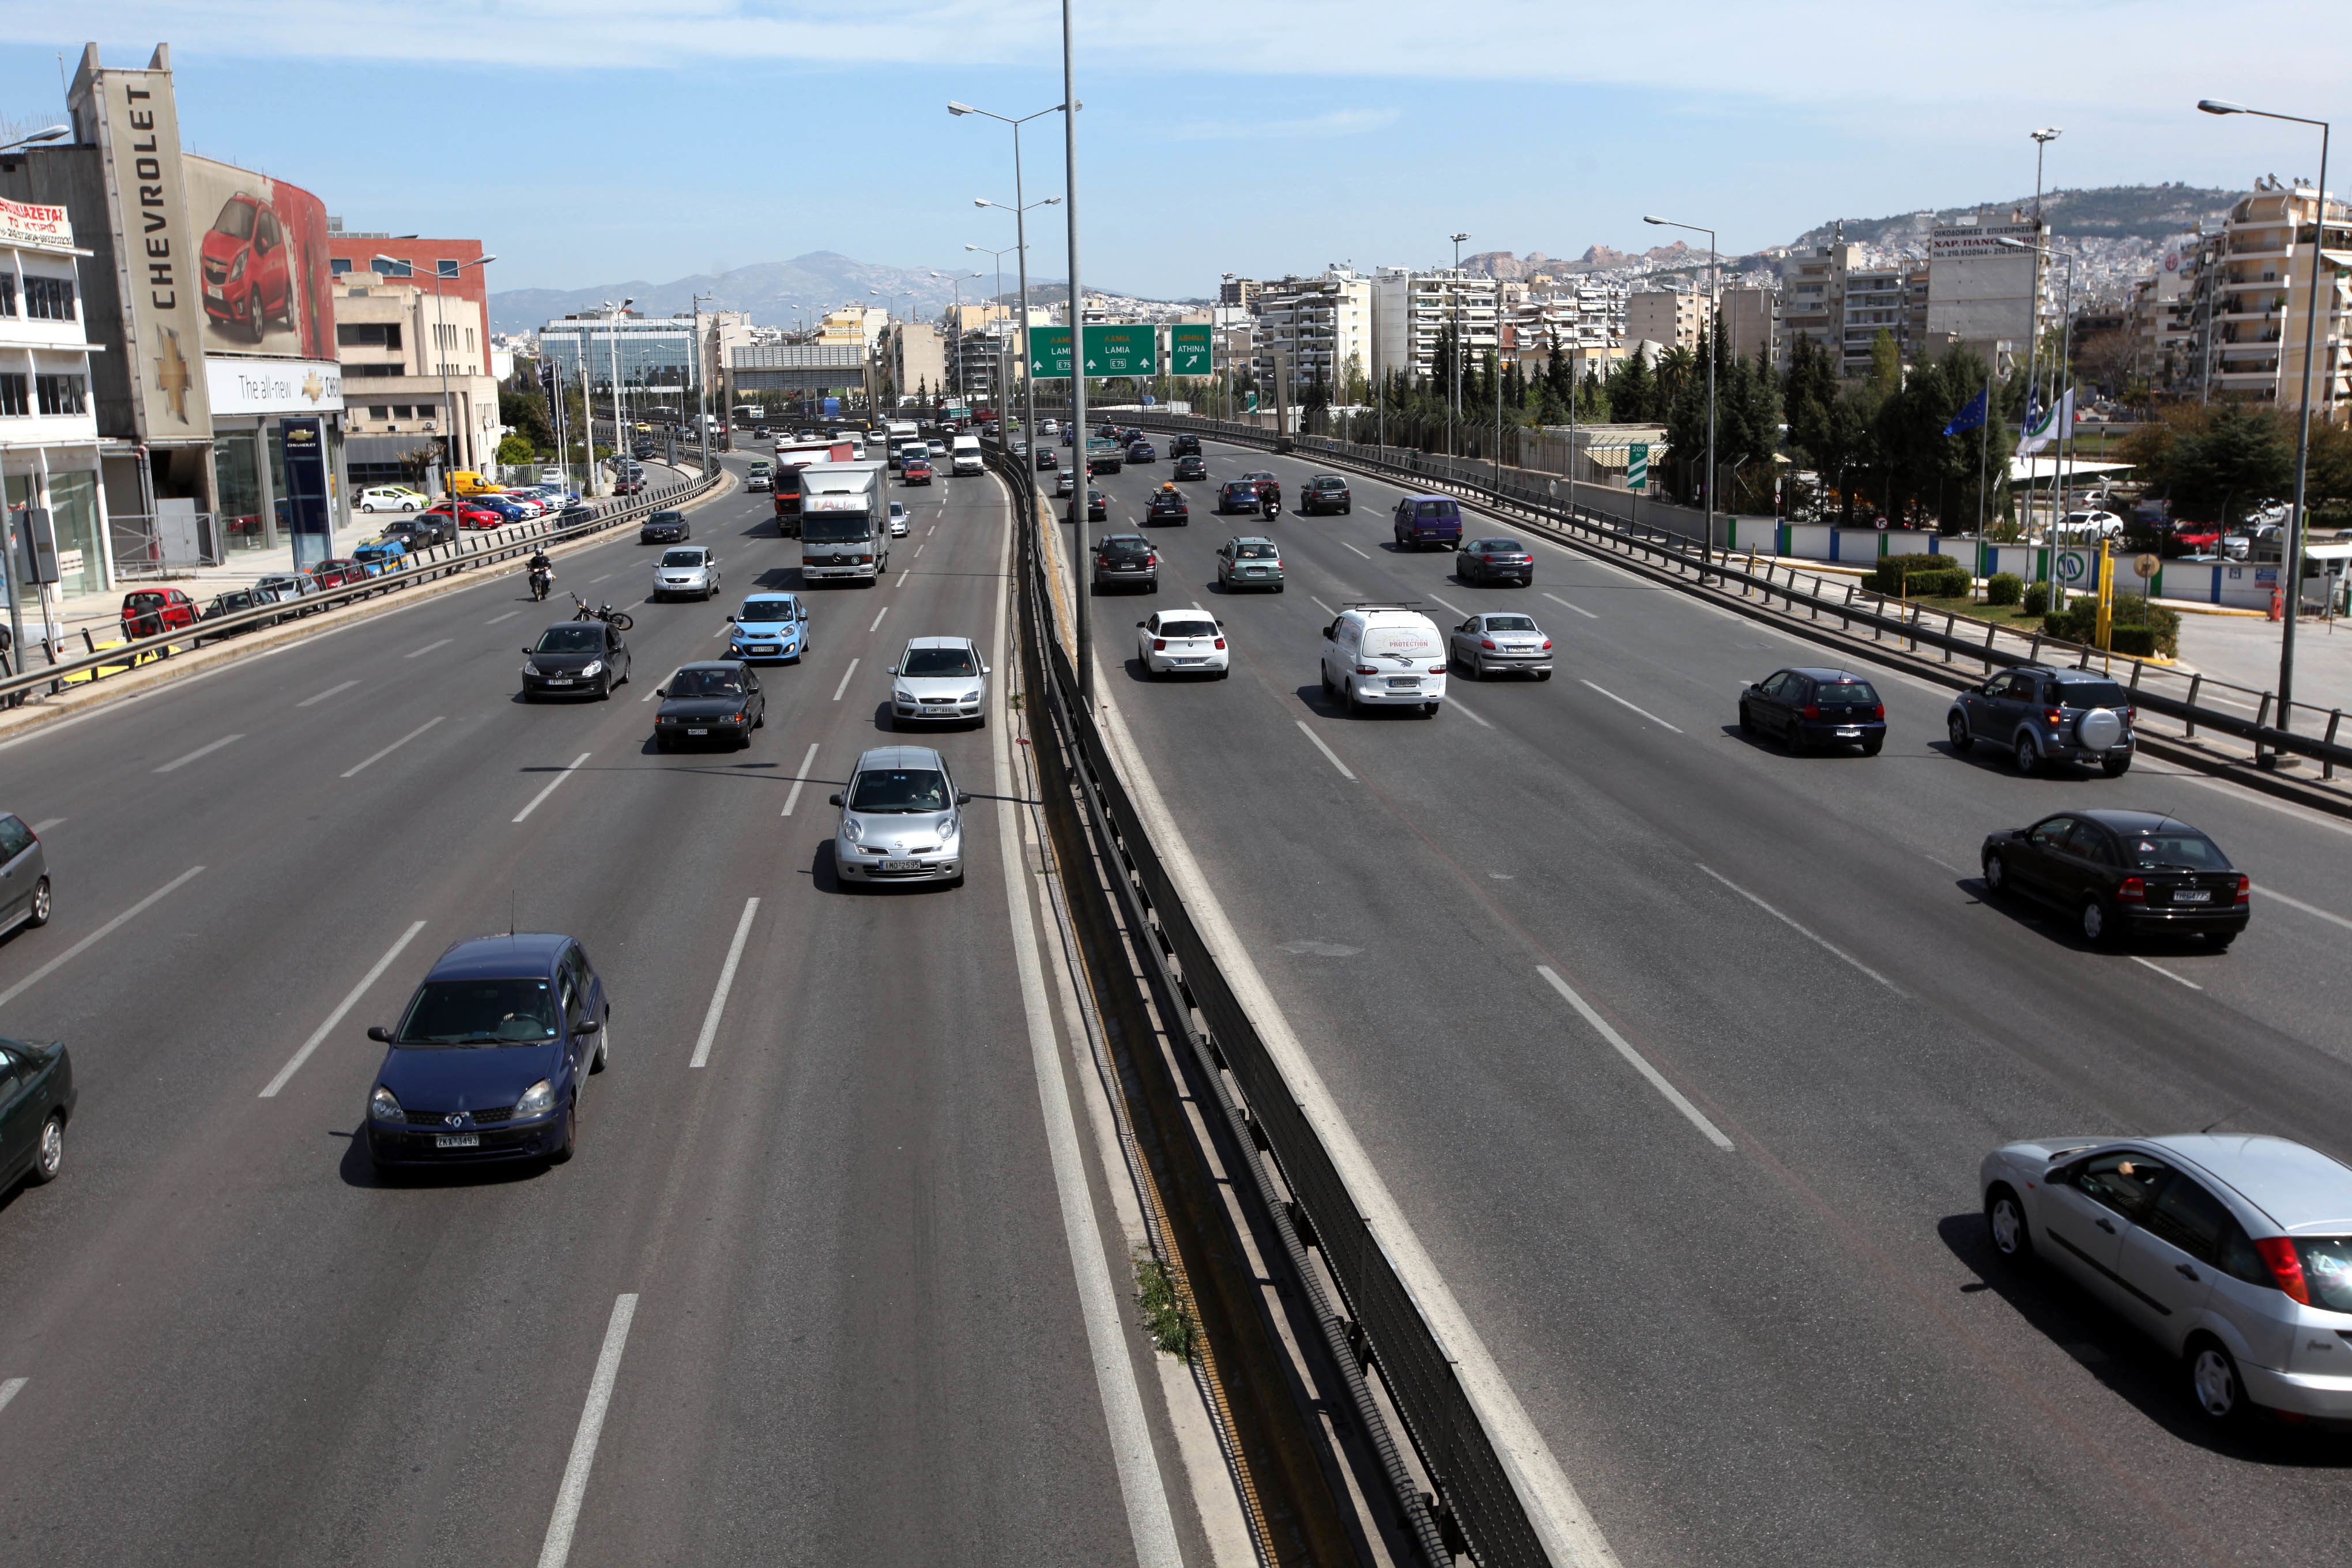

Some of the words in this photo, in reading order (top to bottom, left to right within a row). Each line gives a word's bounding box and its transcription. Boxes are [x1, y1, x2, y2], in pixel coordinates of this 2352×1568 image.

[126, 84, 176, 310] CHEVROLET
[1934, 228, 1983, 238] ΟΙΚΟΔΟΜΙΚΕΣ
[1987, 225, 2034, 235] ΕΠΙΧΕΙΡΗΣΕΙ
[238, 375, 258, 399] The
[261, 375, 291, 399] all-new
